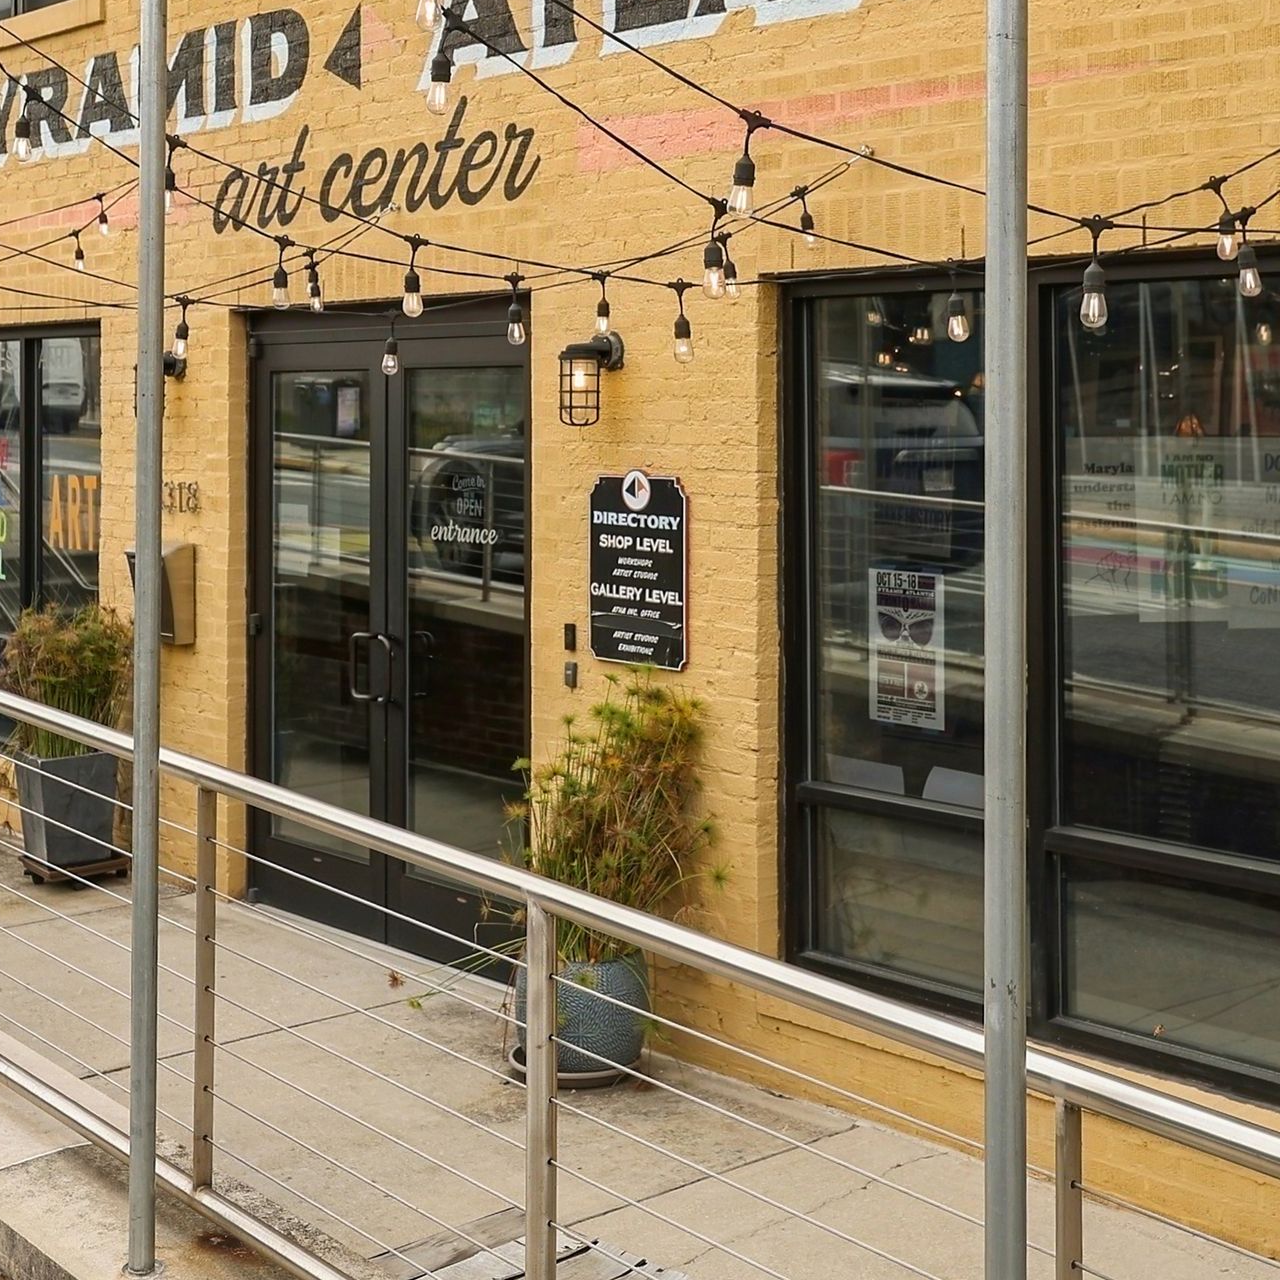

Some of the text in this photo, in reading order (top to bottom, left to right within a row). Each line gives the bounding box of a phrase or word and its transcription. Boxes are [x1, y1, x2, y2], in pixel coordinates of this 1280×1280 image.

[212, 94, 541, 235] art center
[1084, 461, 1135, 476] Maryla
[48, 474, 97, 551] ART
[457, 497, 482, 516] OPEN
[593, 511, 681, 531] DIRECTORY
[431, 518, 499, 545] entrance
[599, 534, 674, 554] SHOP LEVEL
[877, 571, 917, 589] OCT 15-18
[590, 582, 683, 606] GALLERY LEVEL
